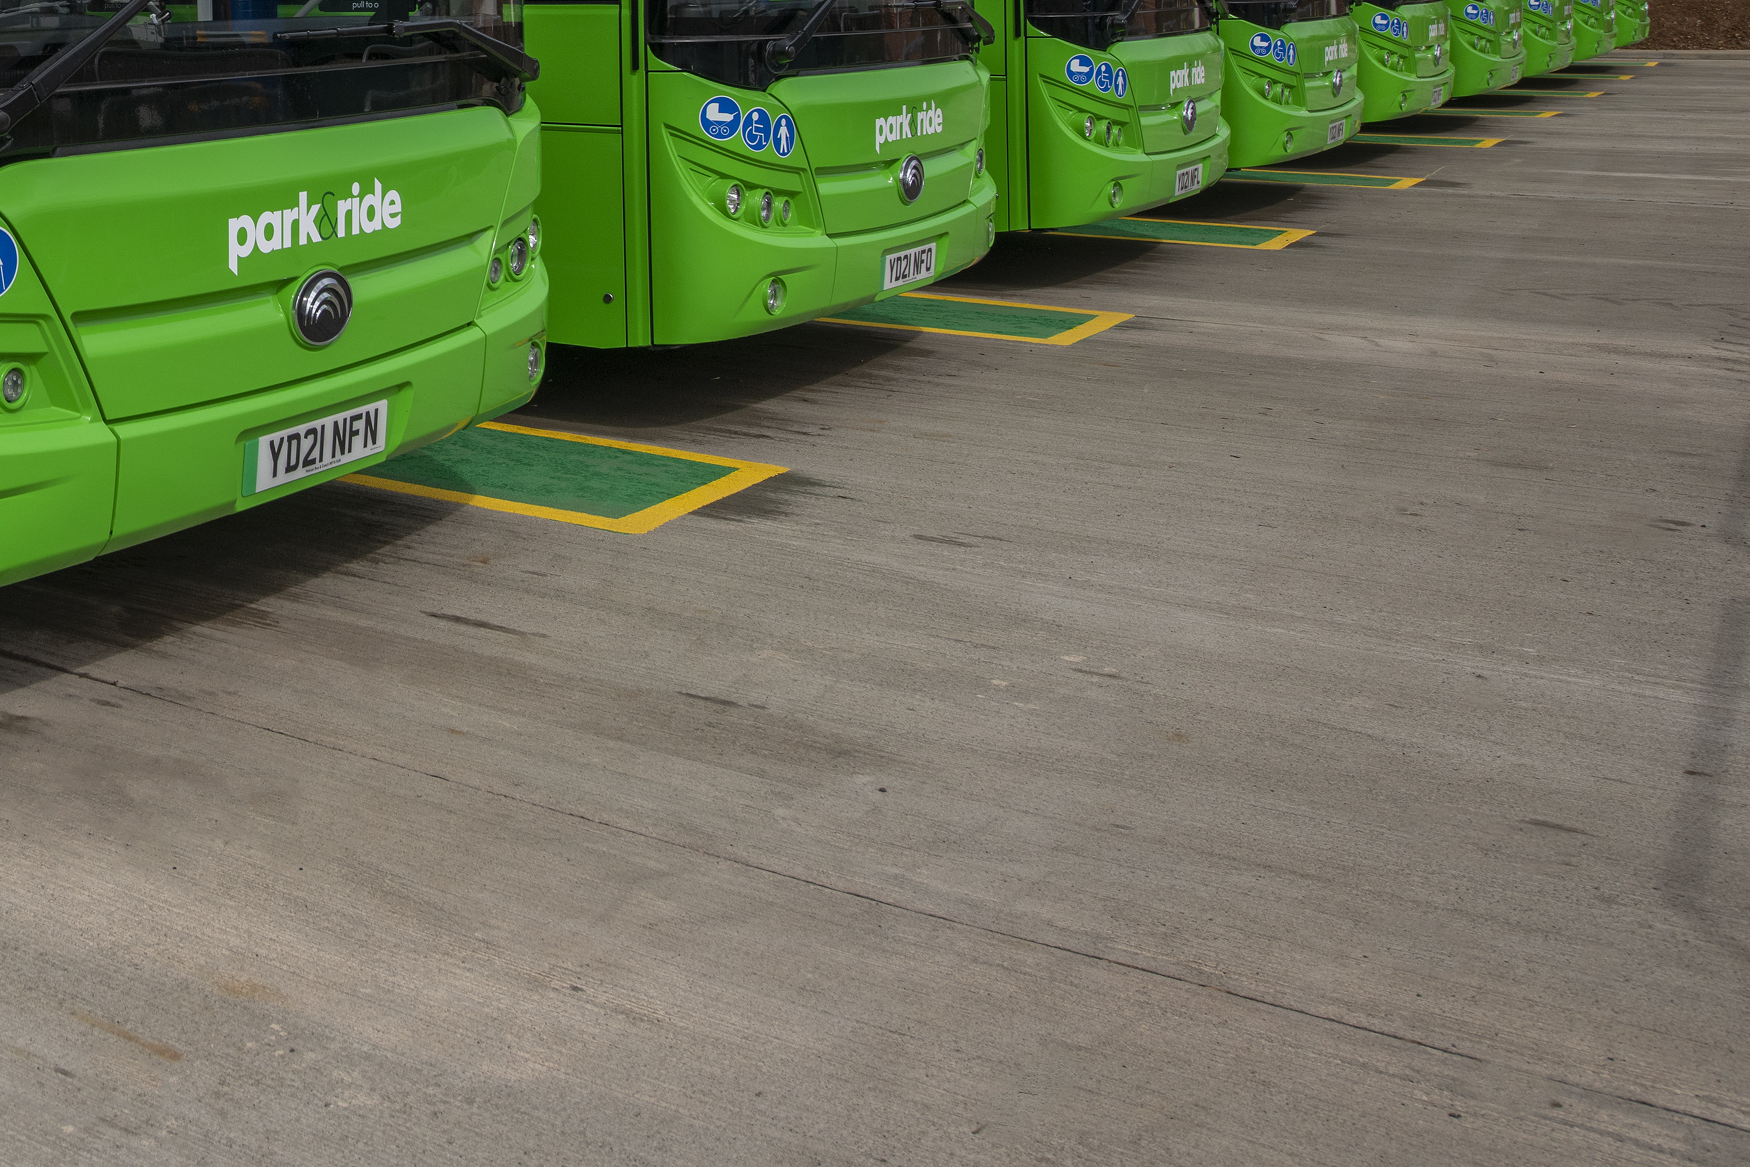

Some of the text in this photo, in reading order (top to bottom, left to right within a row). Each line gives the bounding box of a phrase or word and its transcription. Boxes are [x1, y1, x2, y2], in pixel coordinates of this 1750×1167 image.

[352, 1, 365, 10] pull
[889, 247, 933, 284] YD21 NFO
[269, 408, 379, 479] YD21 NFN
